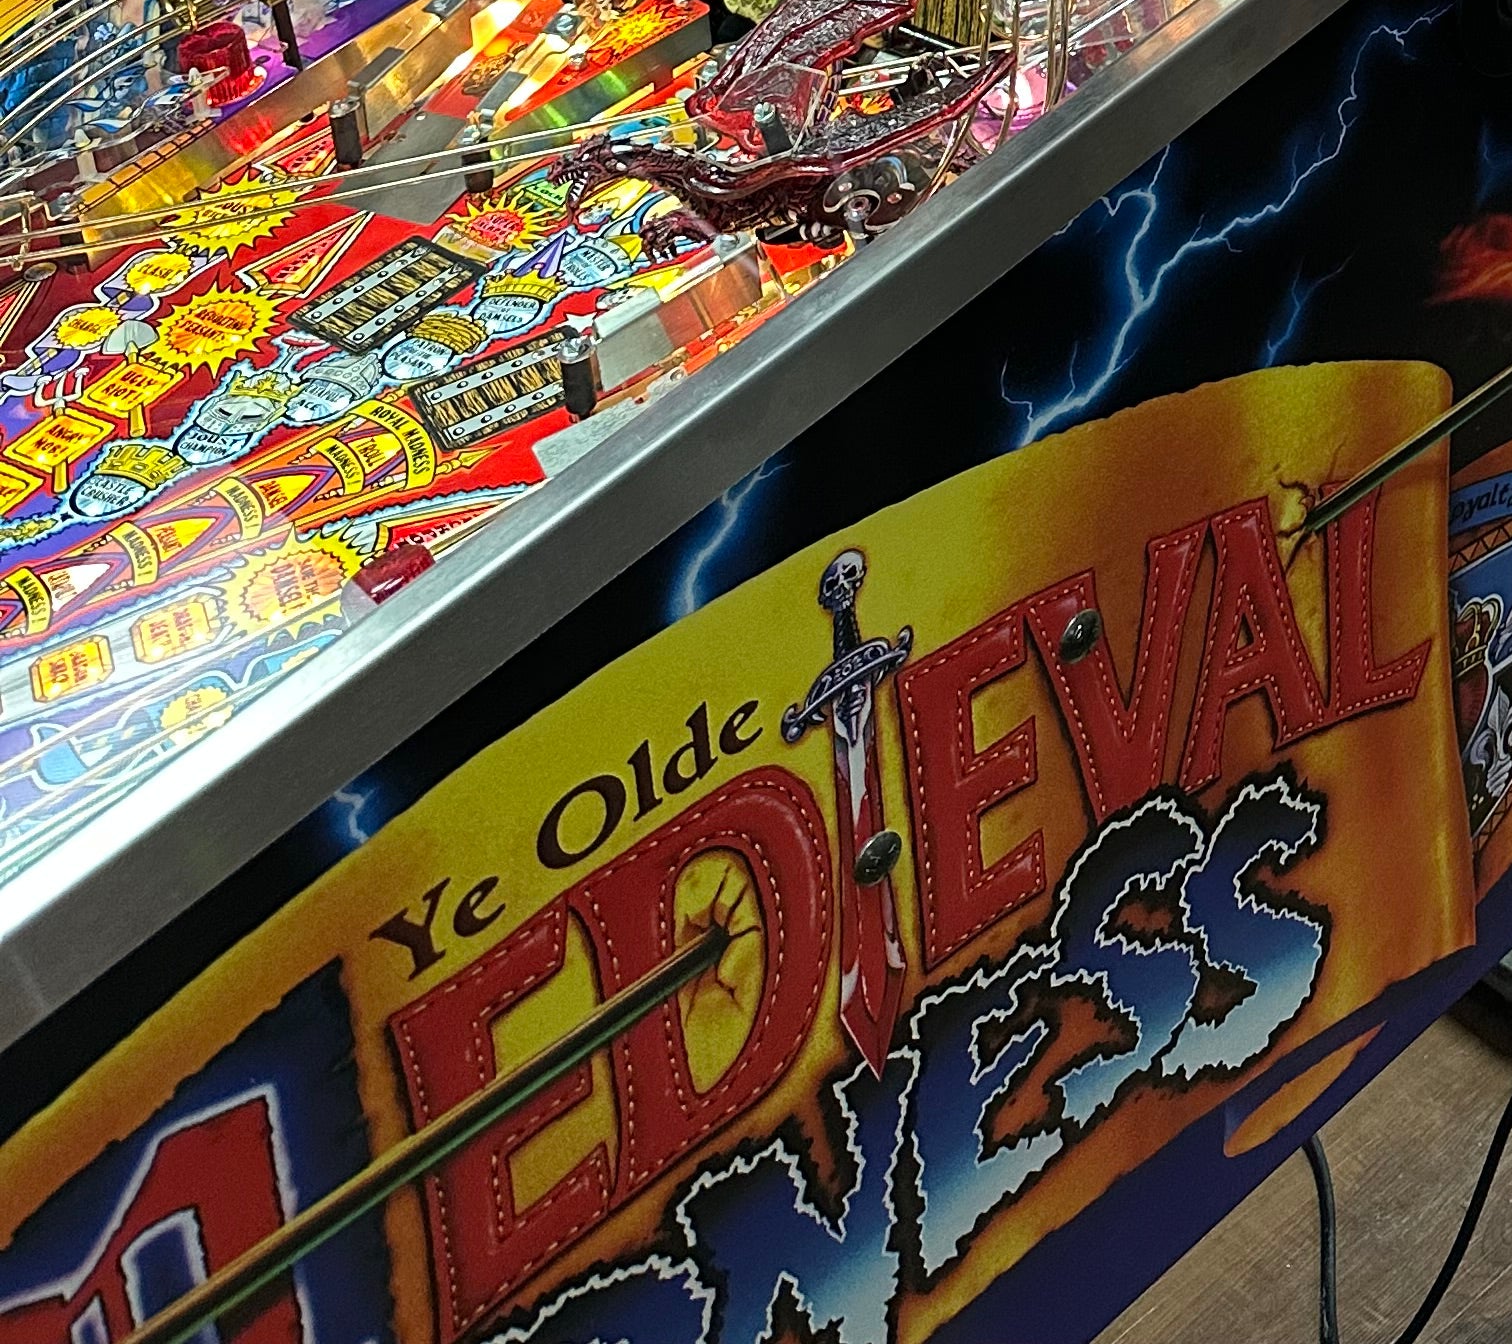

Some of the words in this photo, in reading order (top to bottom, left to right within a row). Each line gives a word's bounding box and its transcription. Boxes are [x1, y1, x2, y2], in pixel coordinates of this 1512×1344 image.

[487, 295, 538, 310] DEFENDER
[478, 312, 524, 325] DAMSELS
[411, 338, 448, 357] PATRON
[388, 349, 435, 374] PEASANTS
[120, 371, 158, 393] UGLY
[101, 385, 144, 406] RIOT!
[297, 399, 319, 412] ACE
[47, 424, 84, 445] ANGRY
[190, 431, 242, 450] JOUST
[368, 405, 406, 432] ROYAL
[408, 429, 432, 477] MADNESS
[33, 435, 70, 458] MOB!
[358, 438, 385, 469] TROLL
[90, 476, 138, 495] CASTLE
[80, 486, 132, 507] CRUSHER
[369, 873, 506, 982] Ye
[535, 696, 765, 870] Olde
